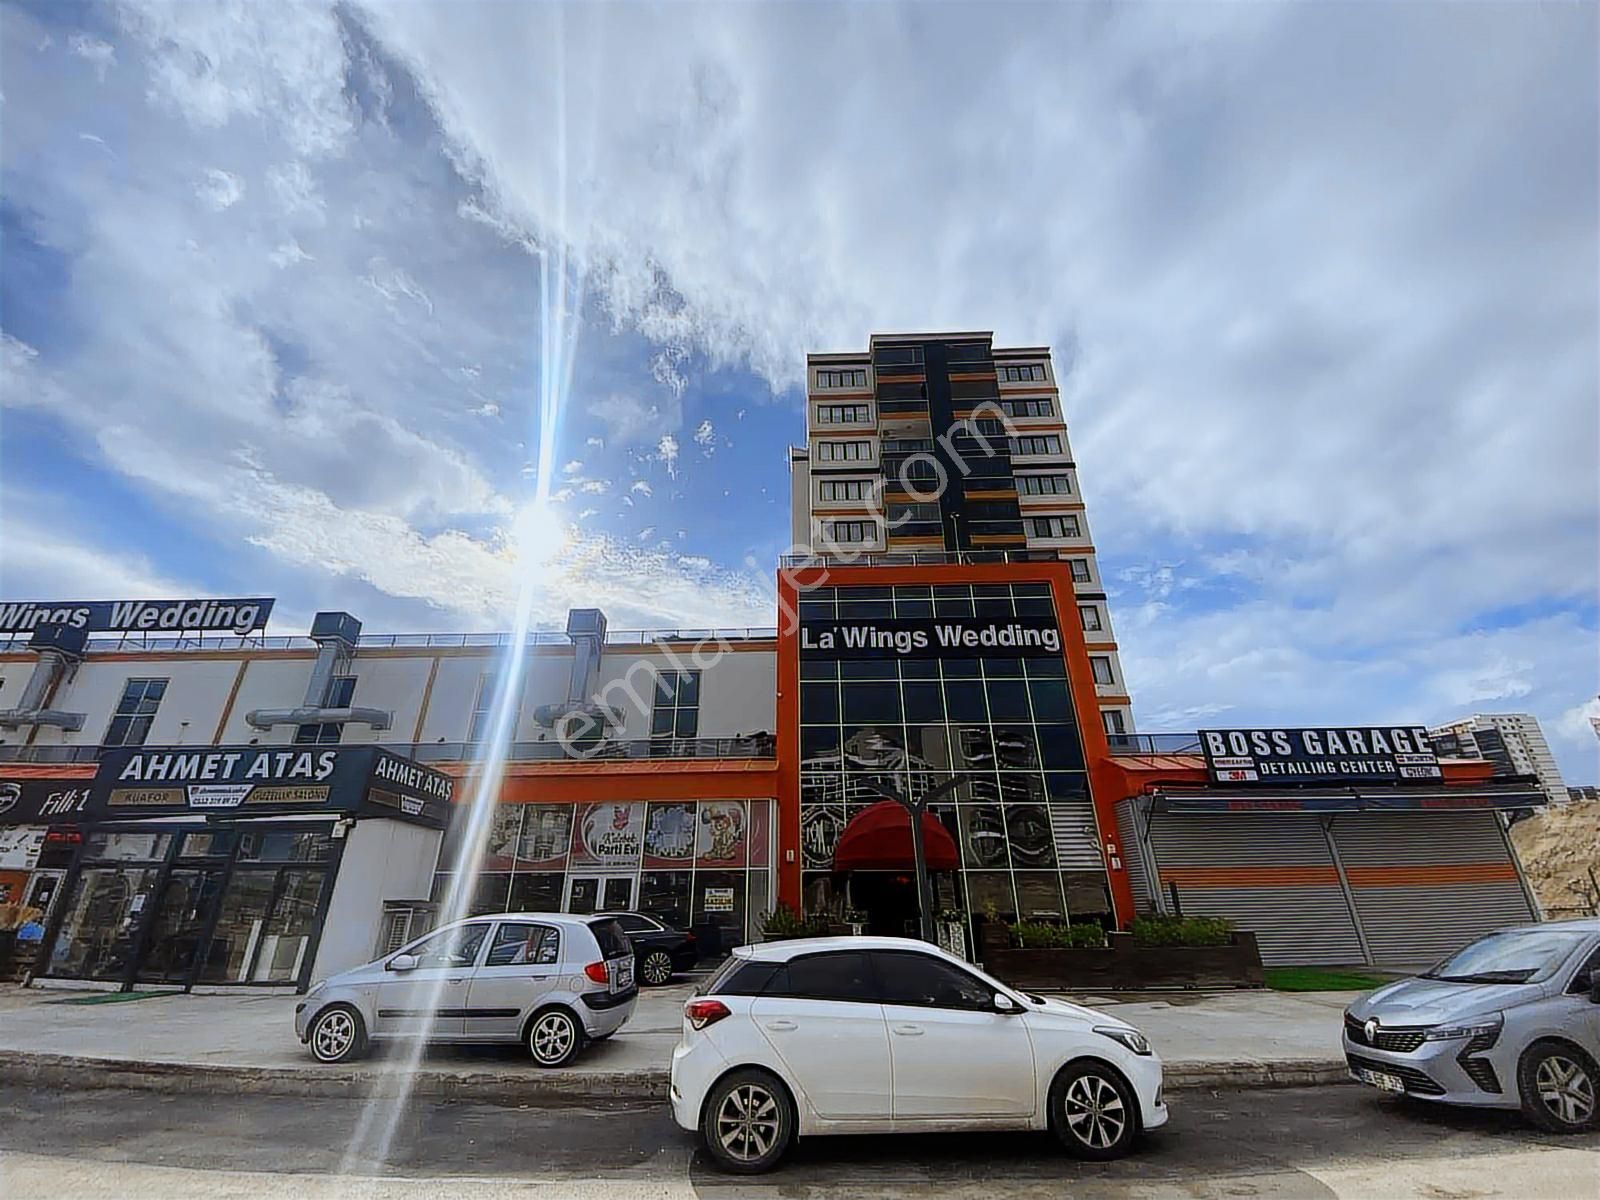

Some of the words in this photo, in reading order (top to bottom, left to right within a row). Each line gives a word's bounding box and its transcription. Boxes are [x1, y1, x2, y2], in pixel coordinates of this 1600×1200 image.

[109, 602, 260, 634] Wedding
[935, 624, 1060, 651] Wedding
[1205, 730, 1292, 756] BOSS
[1302, 728, 1433, 755] GARAGE
[118, 753, 241, 780] AHMET
[245, 751, 336, 781] ATAŞ
[375, 757, 423, 789] AHMET
[1260, 761, 1337, 775] DETAILING
[1340, 760, 1396, 774] CENTER
[599, 844, 622, 856] Parti
[624, 843, 640, 855] Evi
